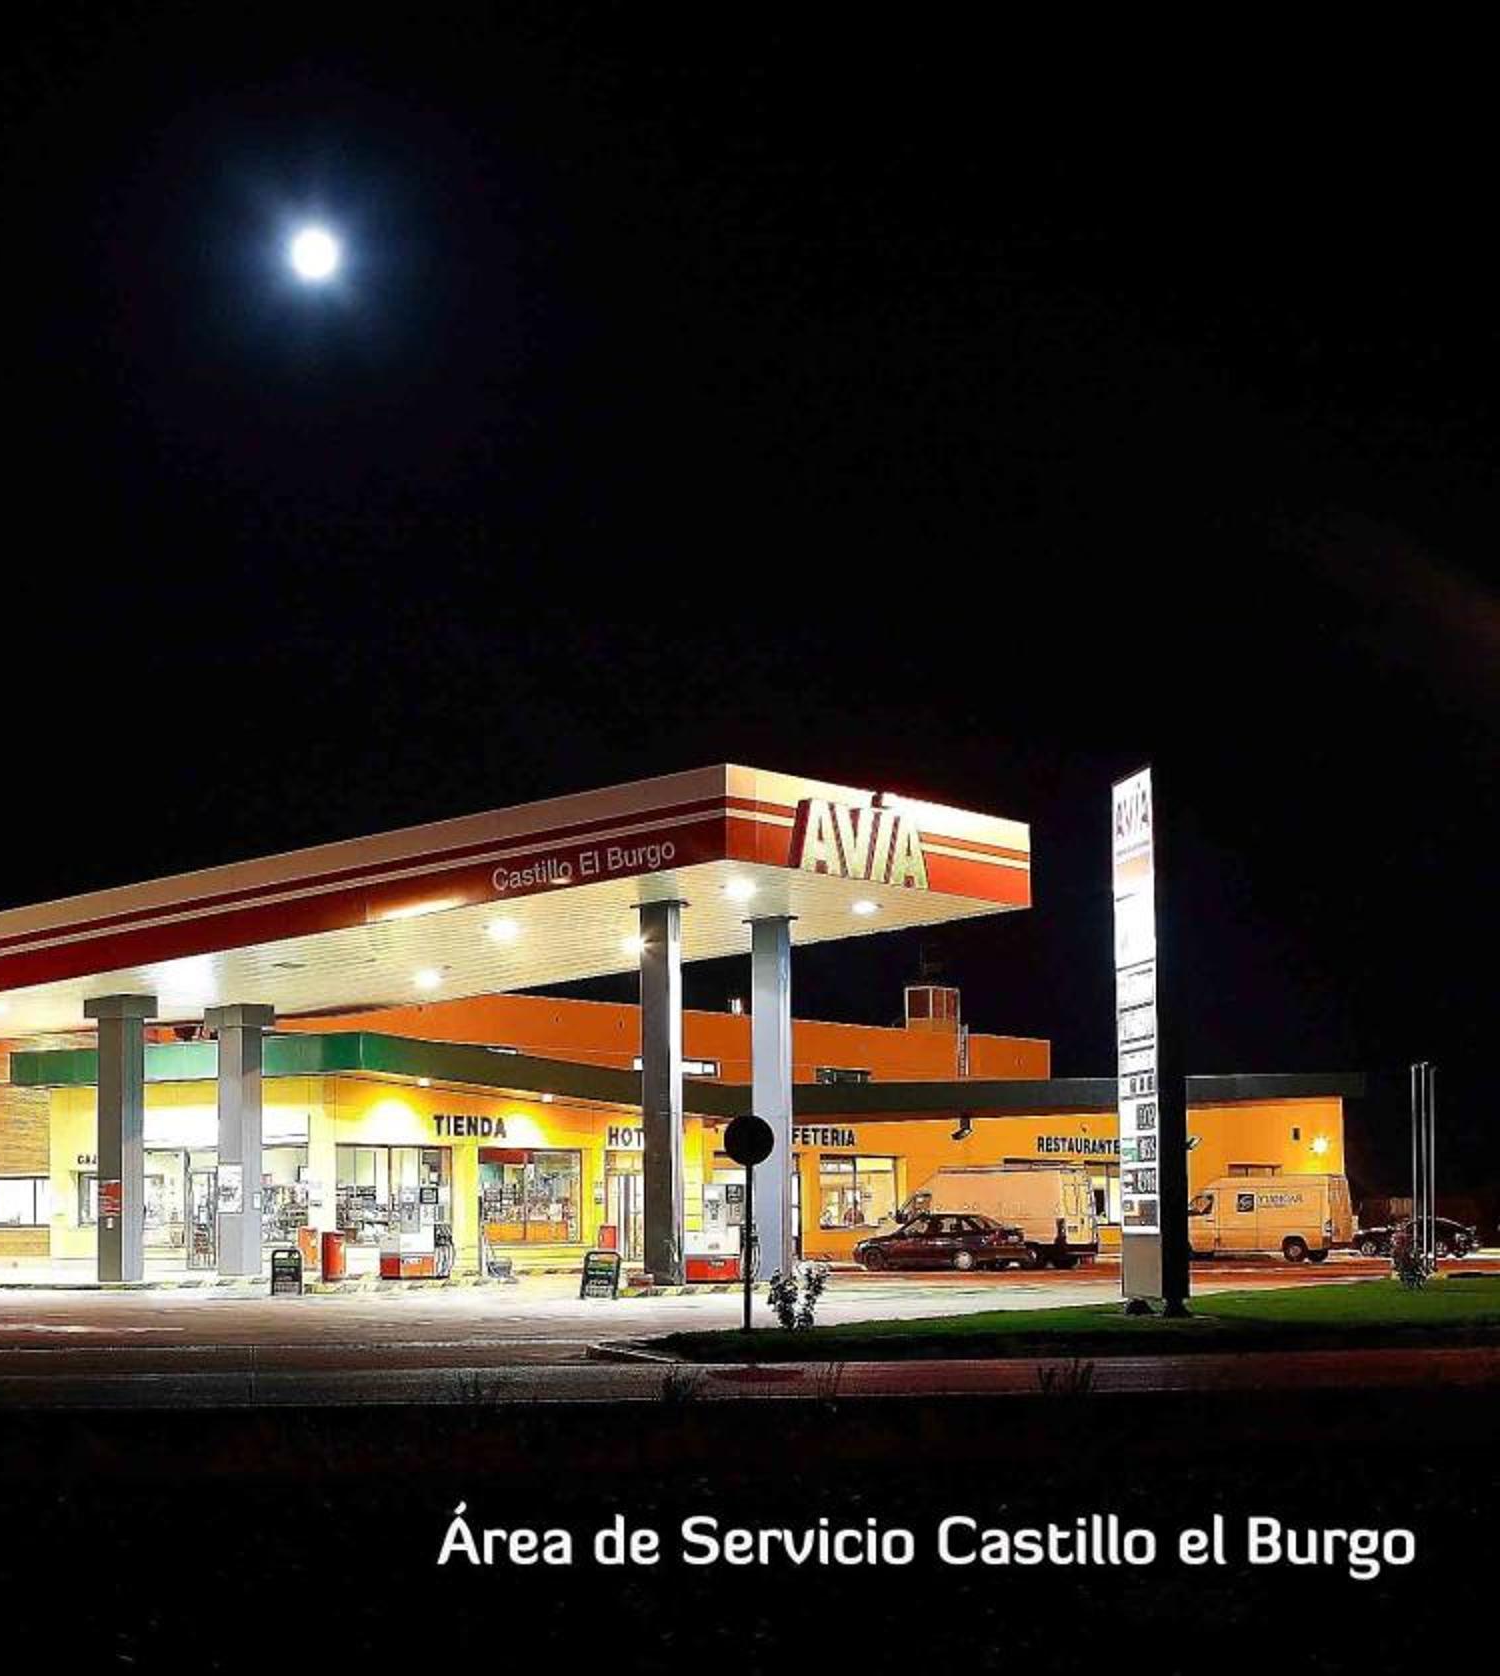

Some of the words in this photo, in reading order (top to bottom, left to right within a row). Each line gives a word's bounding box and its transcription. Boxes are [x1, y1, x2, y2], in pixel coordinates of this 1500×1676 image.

[492, 859, 573, 891] Castillo
[579, 851, 599, 875] El
[606, 841, 675, 871] Burgo
[433, 1115, 507, 1138] TIENDA
[608, 1126, 645, 1147] HOT
[791, 1127, 855, 1146] FETERIA
[1037, 1137, 1120, 1154] RESTAURANTE
[77, 1154, 97, 1165] CAJ
